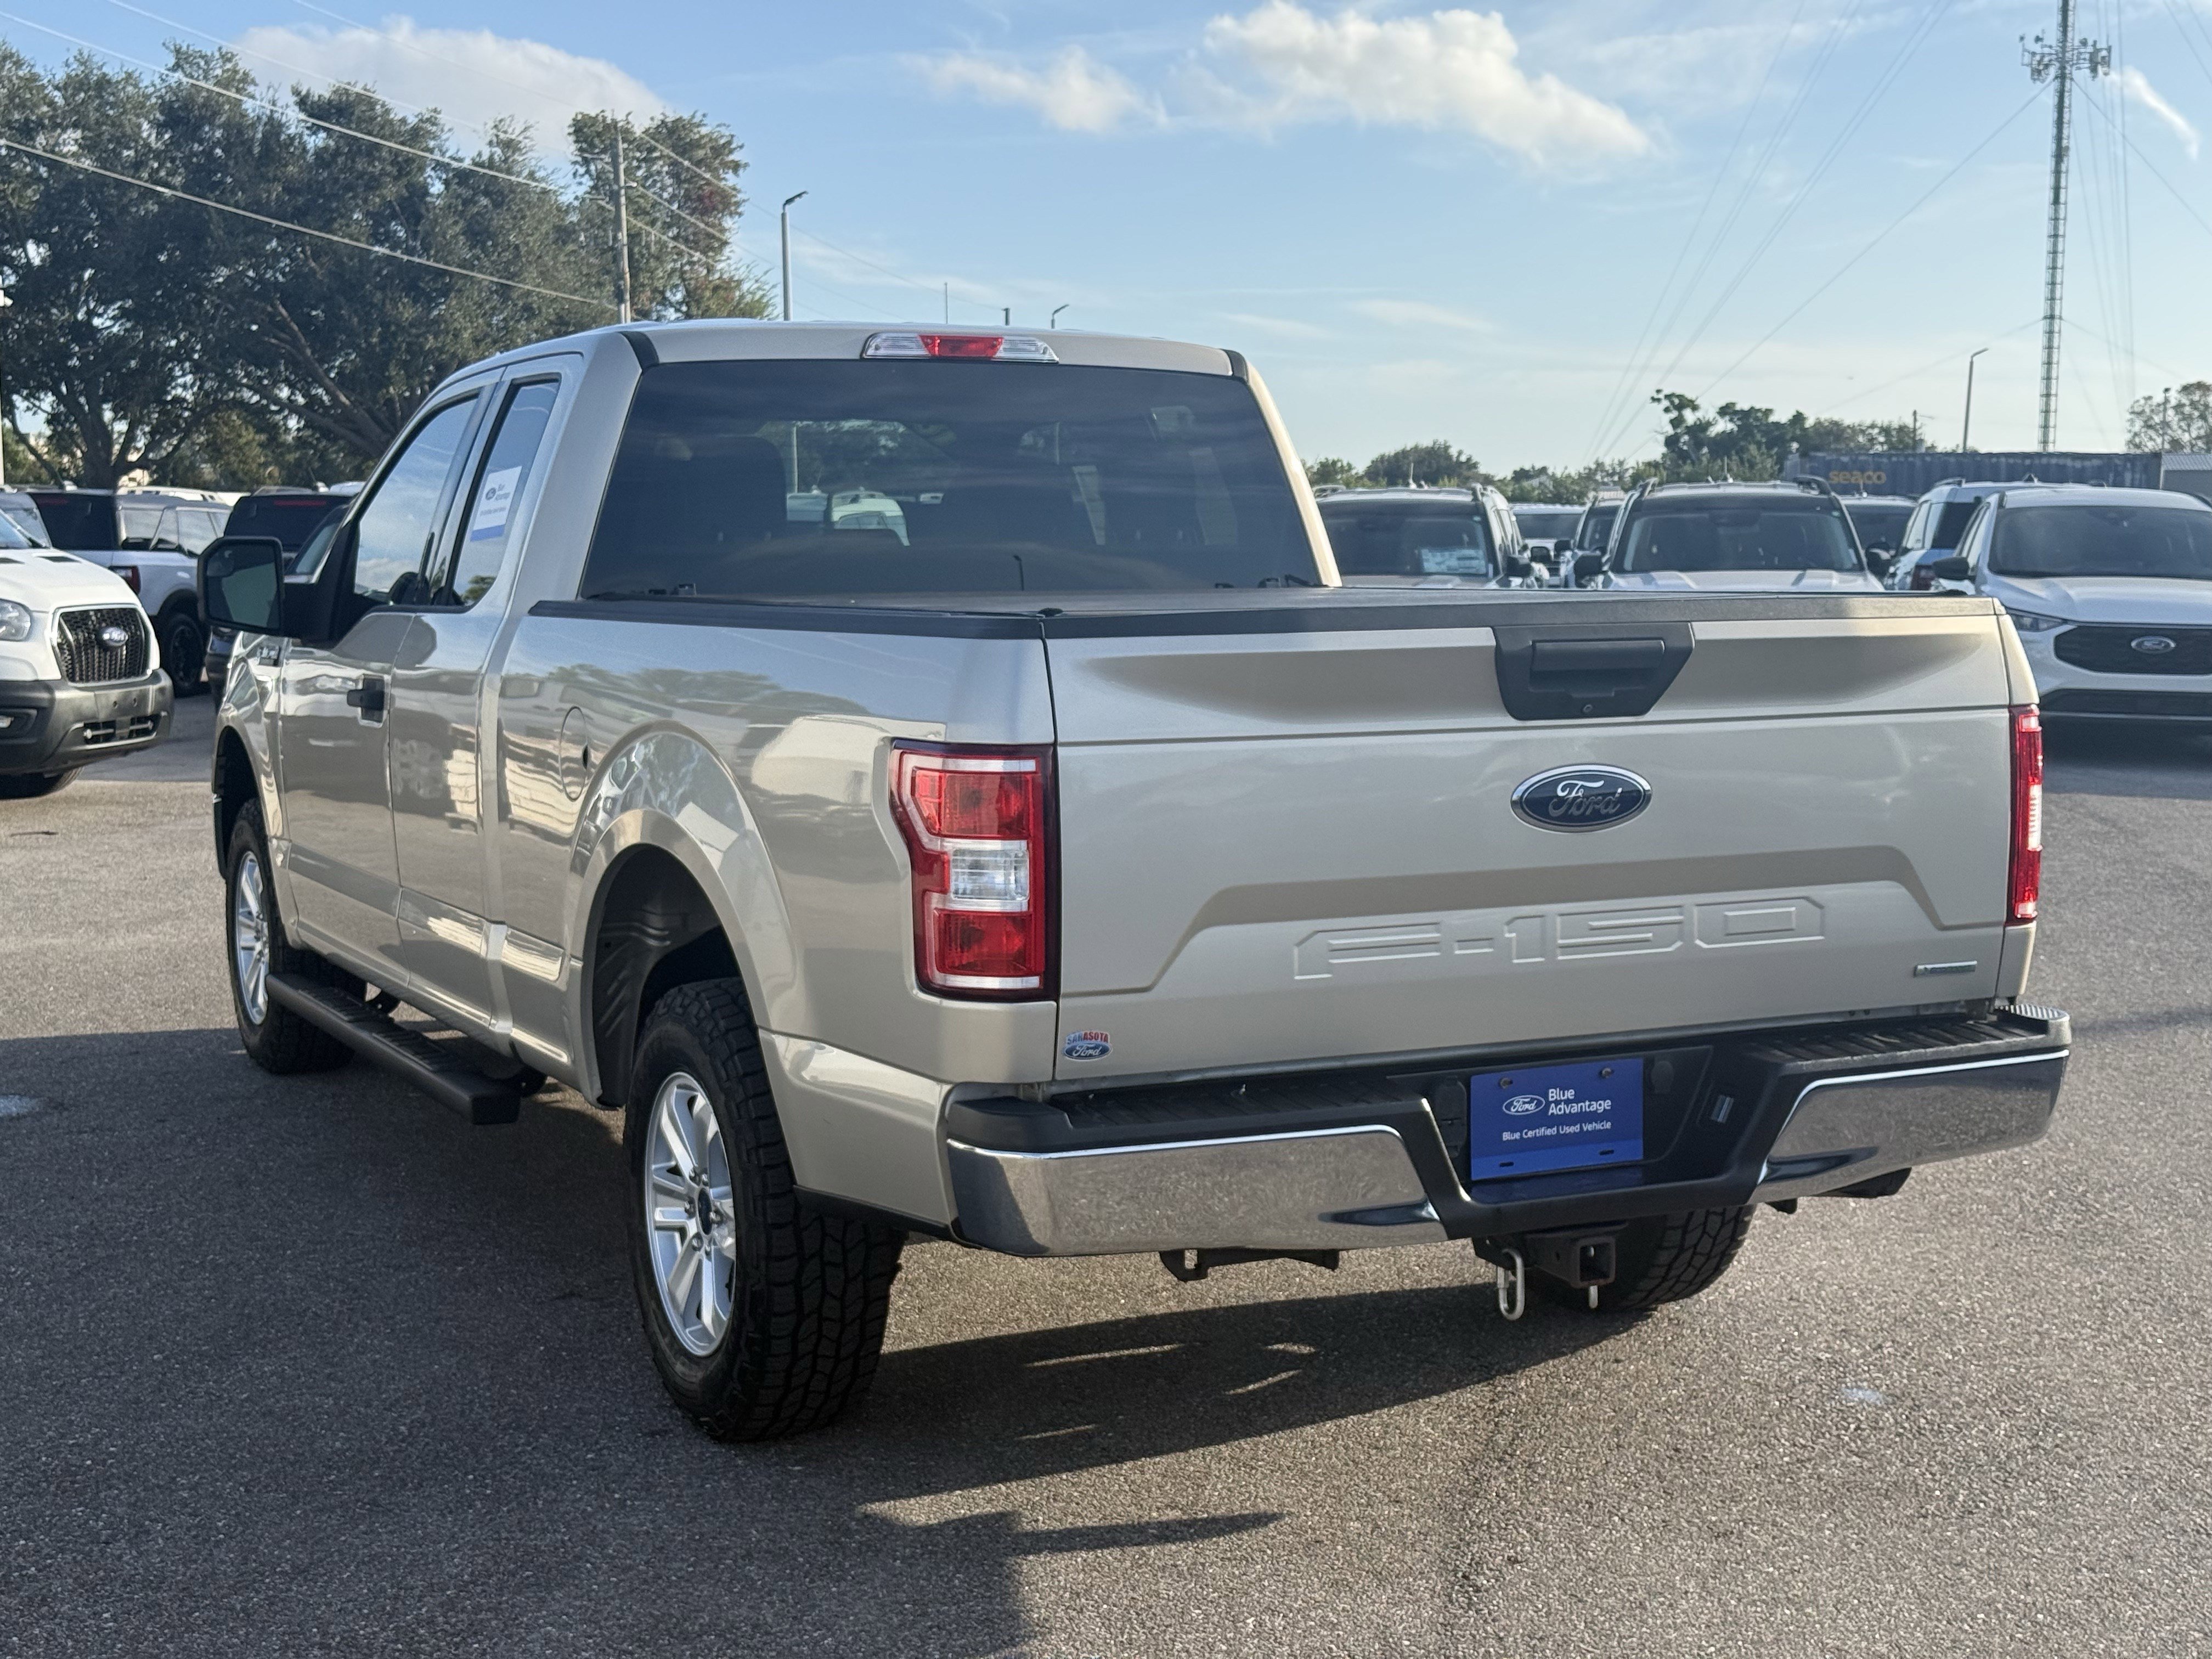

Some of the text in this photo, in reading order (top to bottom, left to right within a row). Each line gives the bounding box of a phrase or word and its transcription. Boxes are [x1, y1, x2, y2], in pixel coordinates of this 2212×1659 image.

[1829, 470, 1887, 484] seaco
[1548, 780, 1623, 817] Ford
[1294, 896, 1825, 980] F-150
[1072, 1043, 1102, 1057] Ford
[1548, 1087, 1575, 1101] Blue
[1510, 1098, 1538, 1112] Ford
[1548, 1099, 1612, 1115] Advantage
[1502, 1120, 1612, 1141] Blue Certified Used Vehicle
